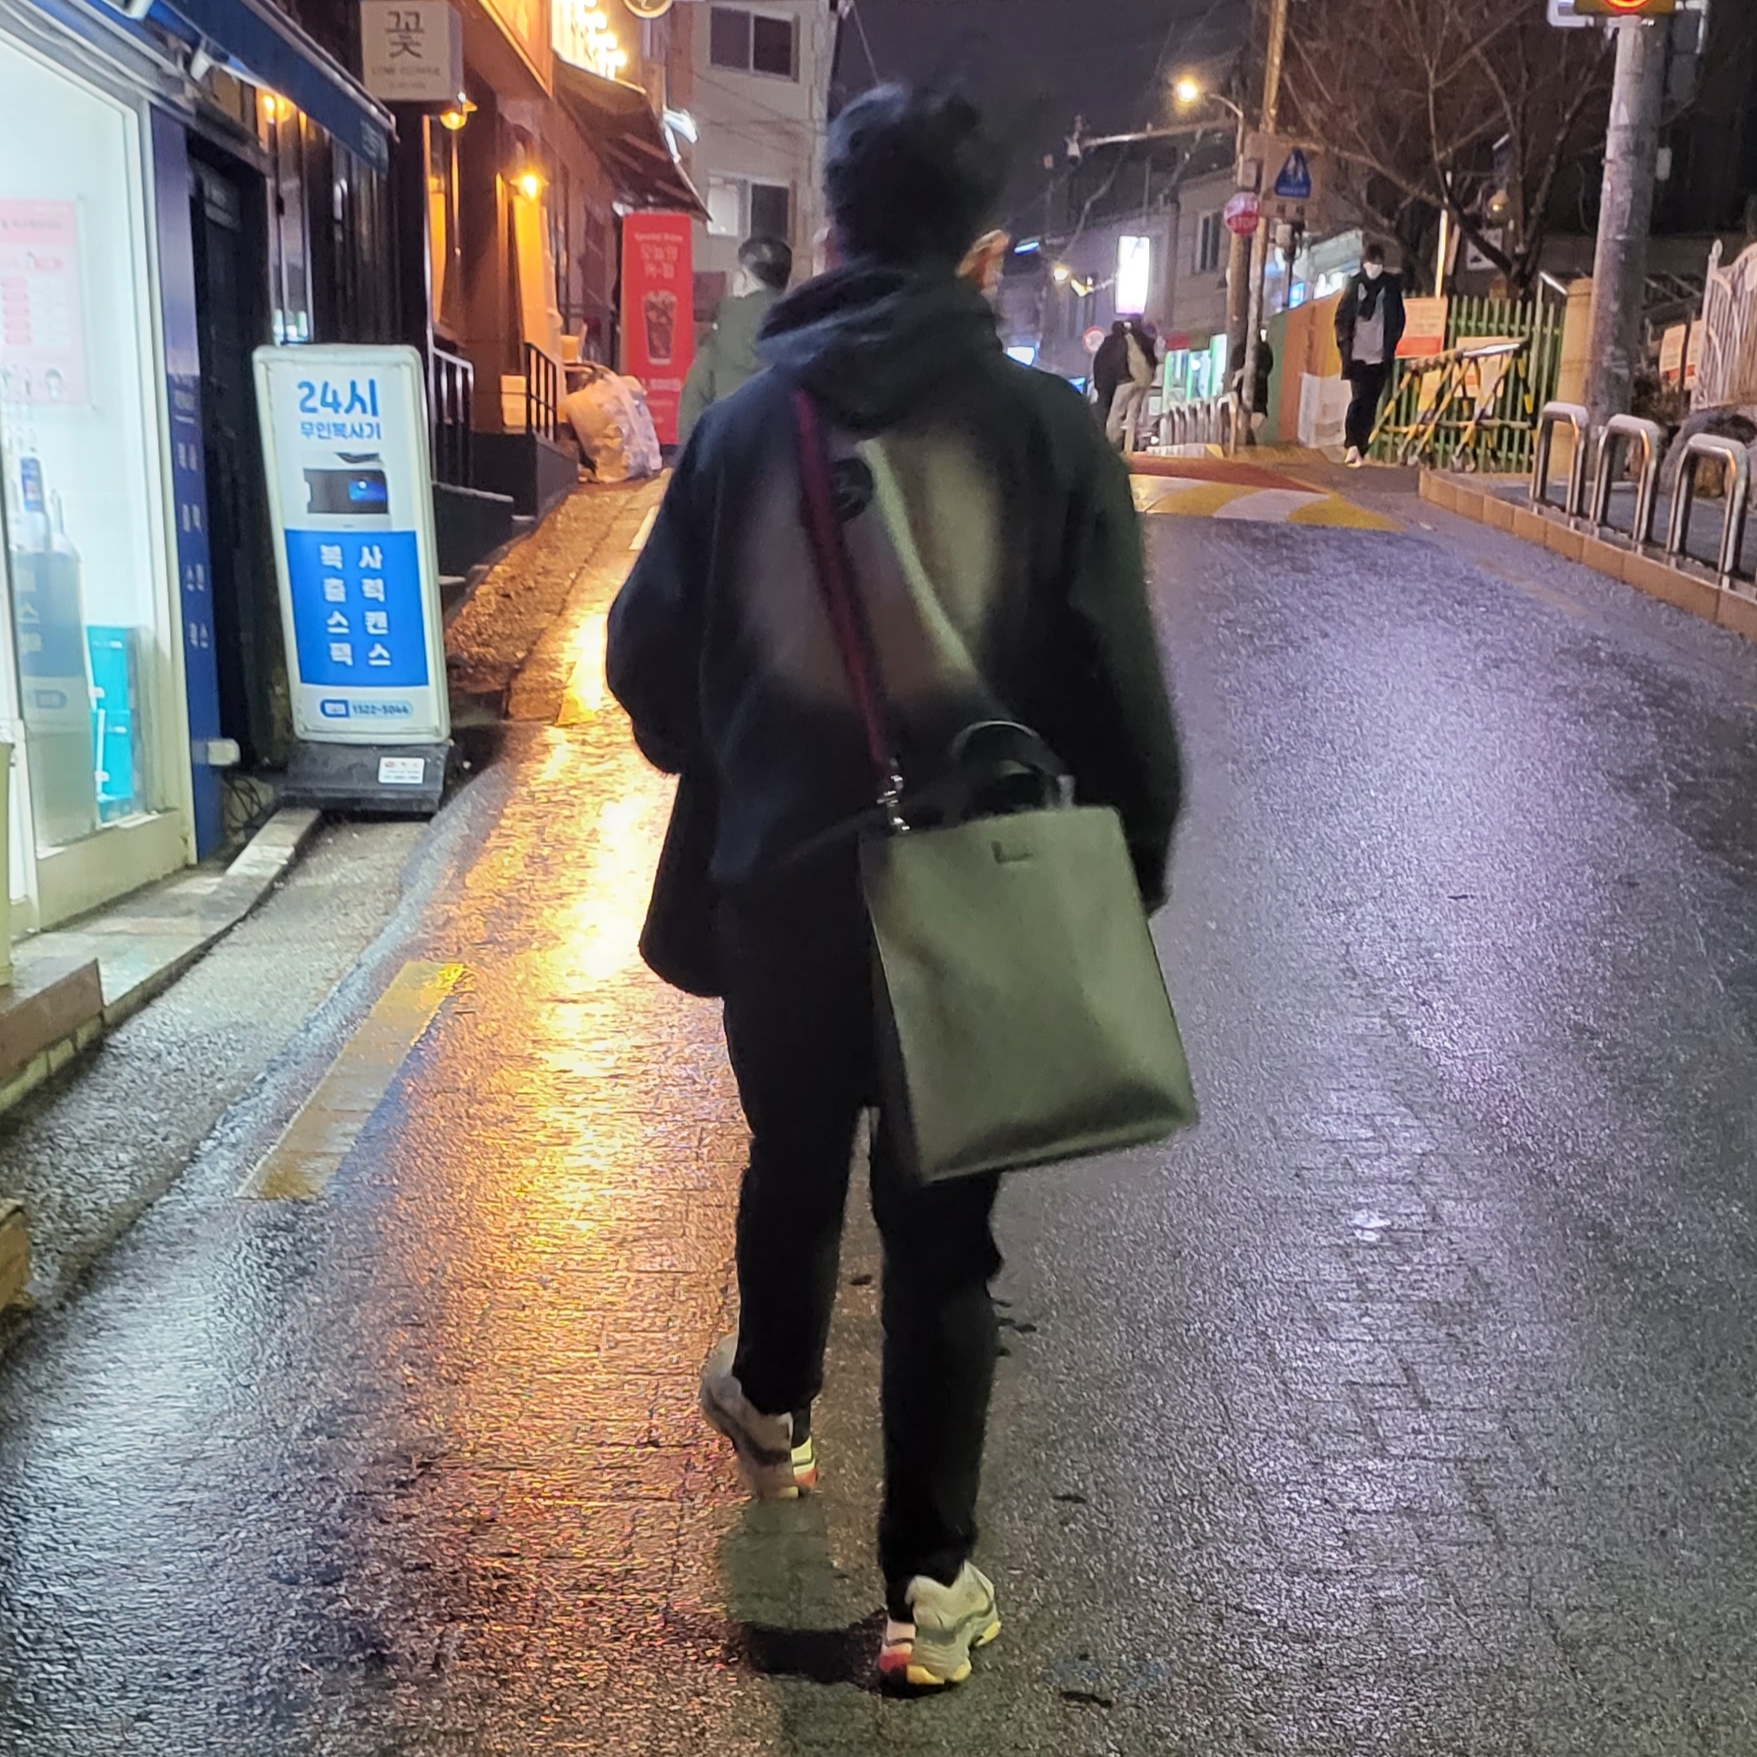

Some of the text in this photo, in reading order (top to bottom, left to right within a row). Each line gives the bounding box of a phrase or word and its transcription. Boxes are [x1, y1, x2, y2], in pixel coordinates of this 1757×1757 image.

[385, 10, 425, 58] 꽃
[297, 379, 379, 417] 24시
[300, 421, 381, 440] 무인복사기
